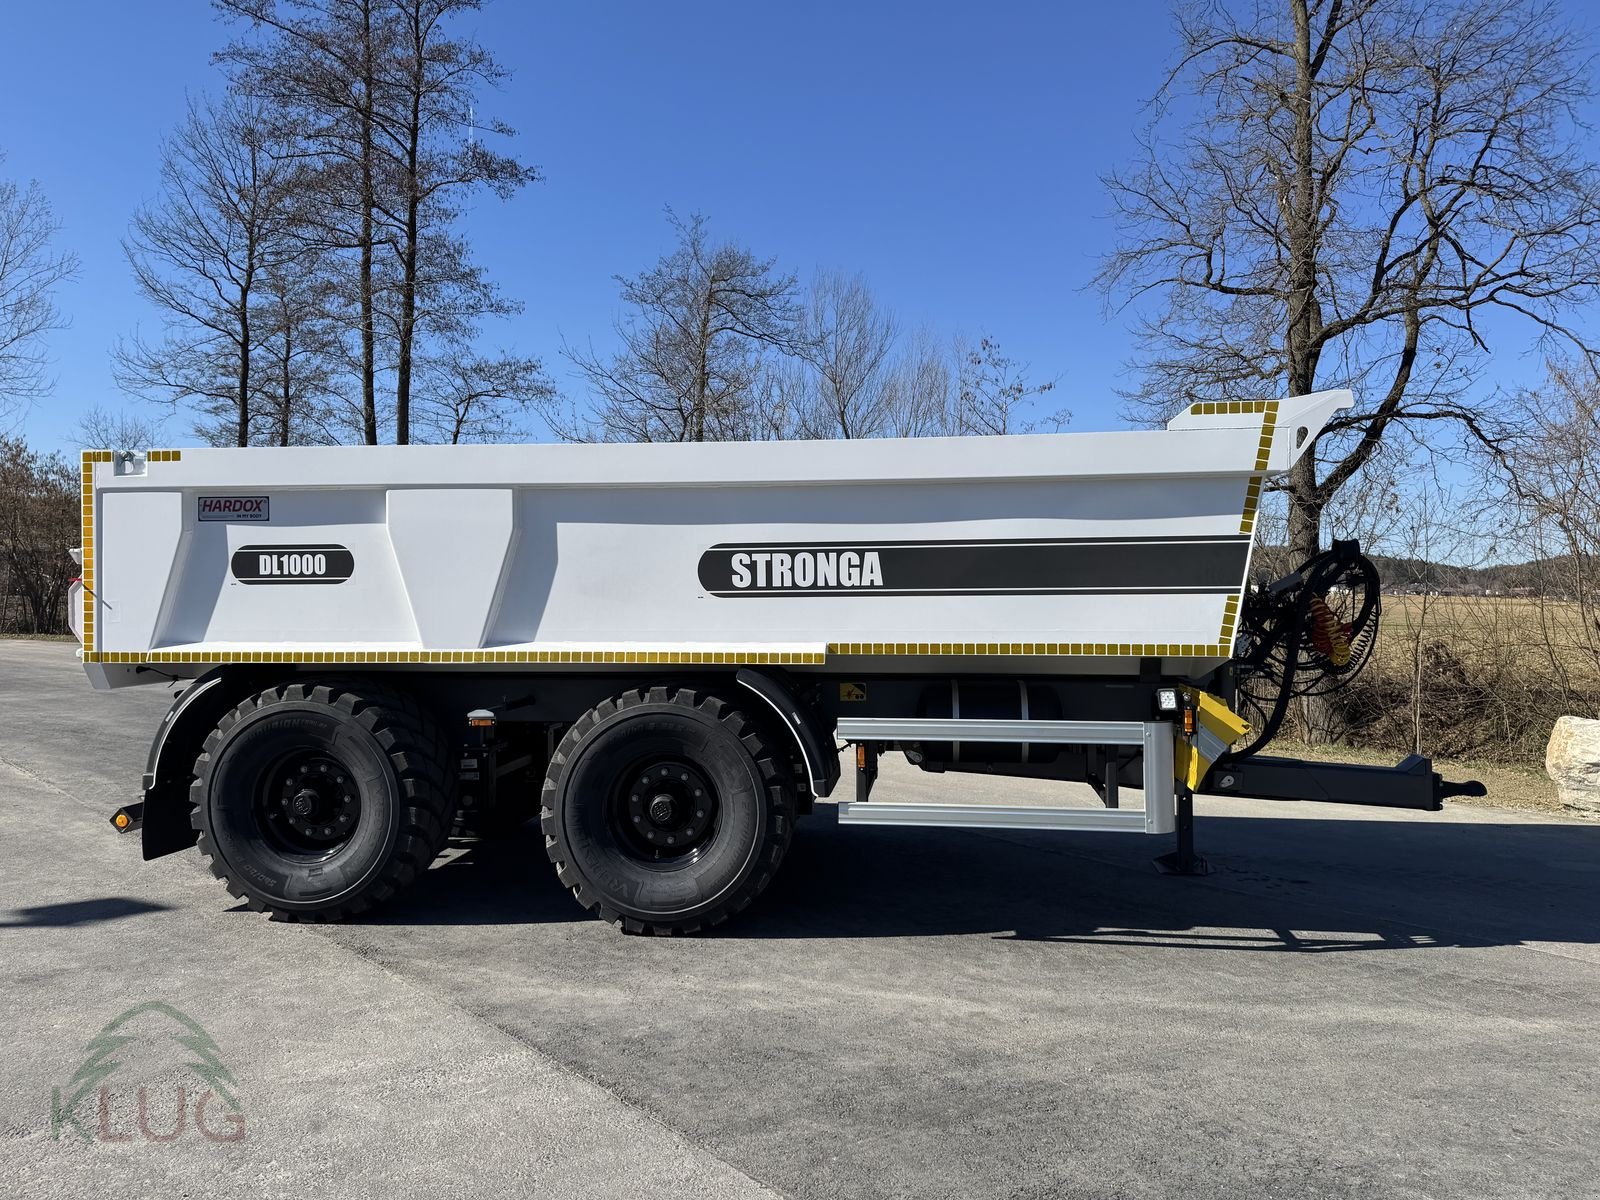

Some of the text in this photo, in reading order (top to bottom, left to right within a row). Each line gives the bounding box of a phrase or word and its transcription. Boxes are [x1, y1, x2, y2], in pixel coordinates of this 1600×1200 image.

[202, 499, 263, 512] HARDOX
[258, 553, 326, 575] DL1000
[731, 551, 883, 588] STRONGA
